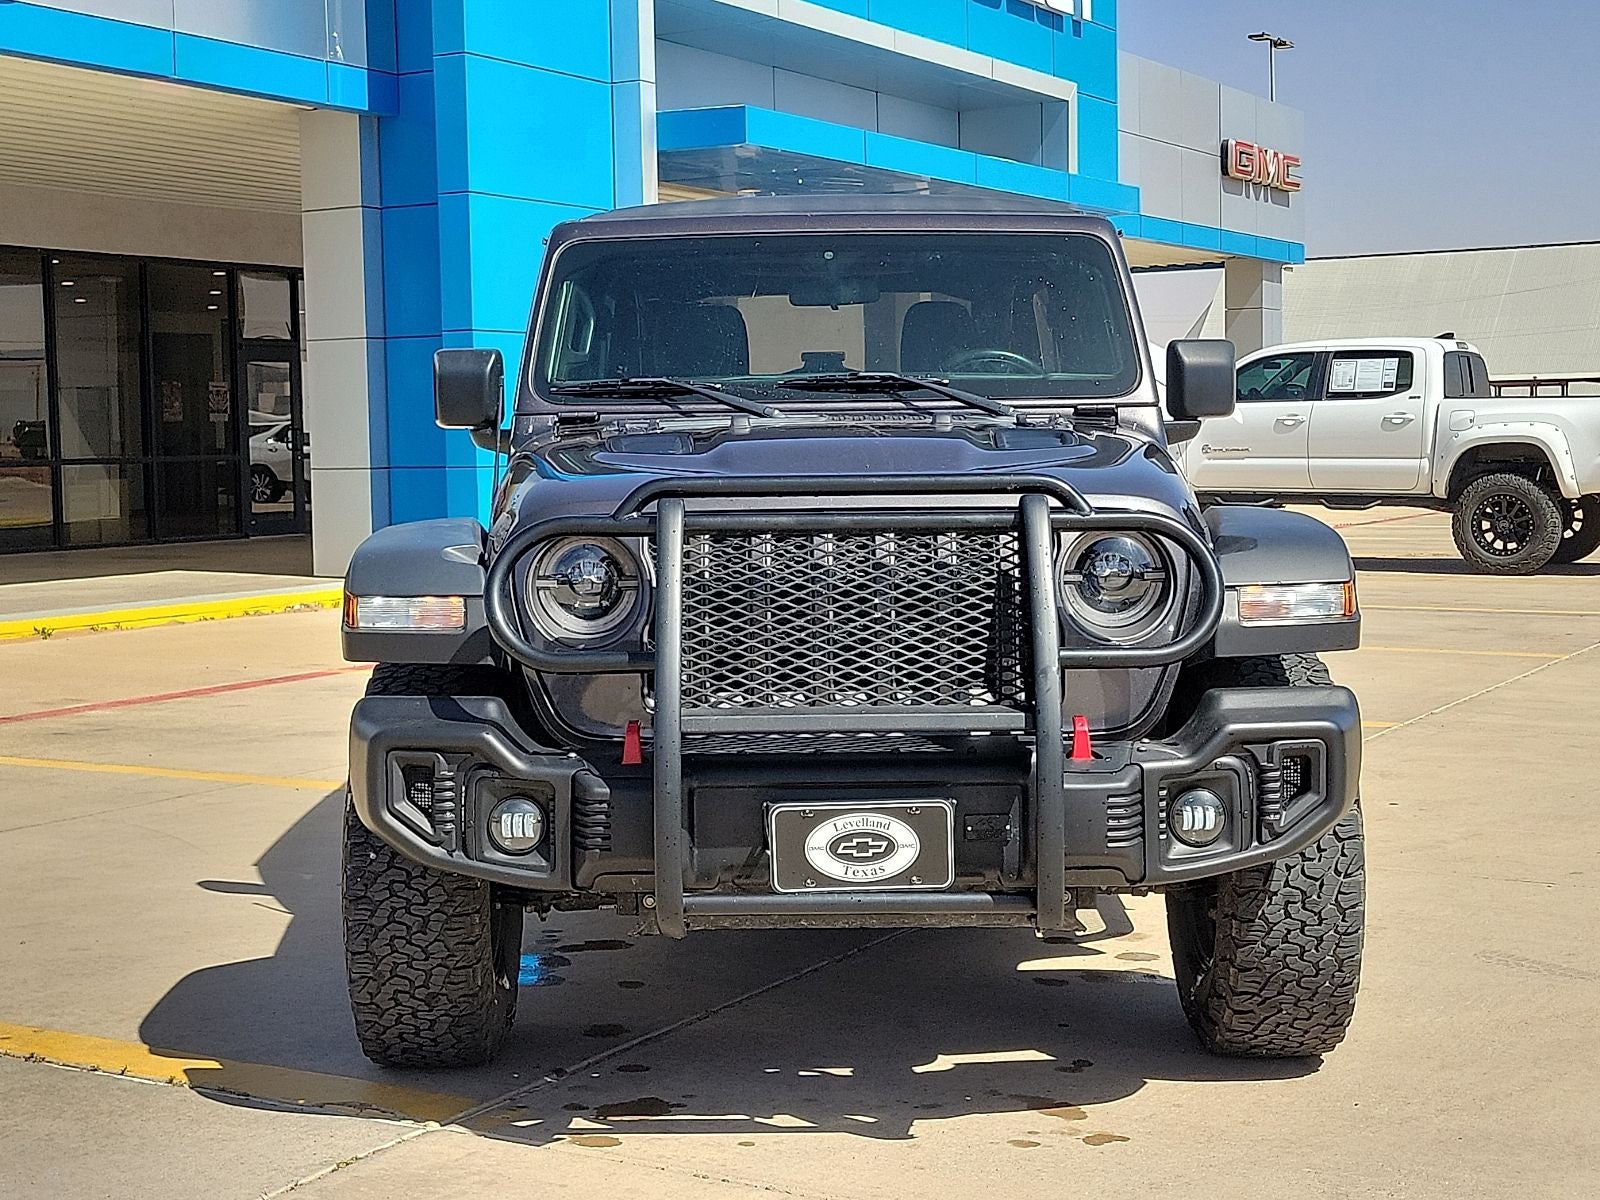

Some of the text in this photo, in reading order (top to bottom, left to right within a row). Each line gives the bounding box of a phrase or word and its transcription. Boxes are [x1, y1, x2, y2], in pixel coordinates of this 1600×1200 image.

[1222, 138, 1301, 192] GMC
[833, 817, 891, 832] Levelland
[842, 865, 886, 877] Texas
